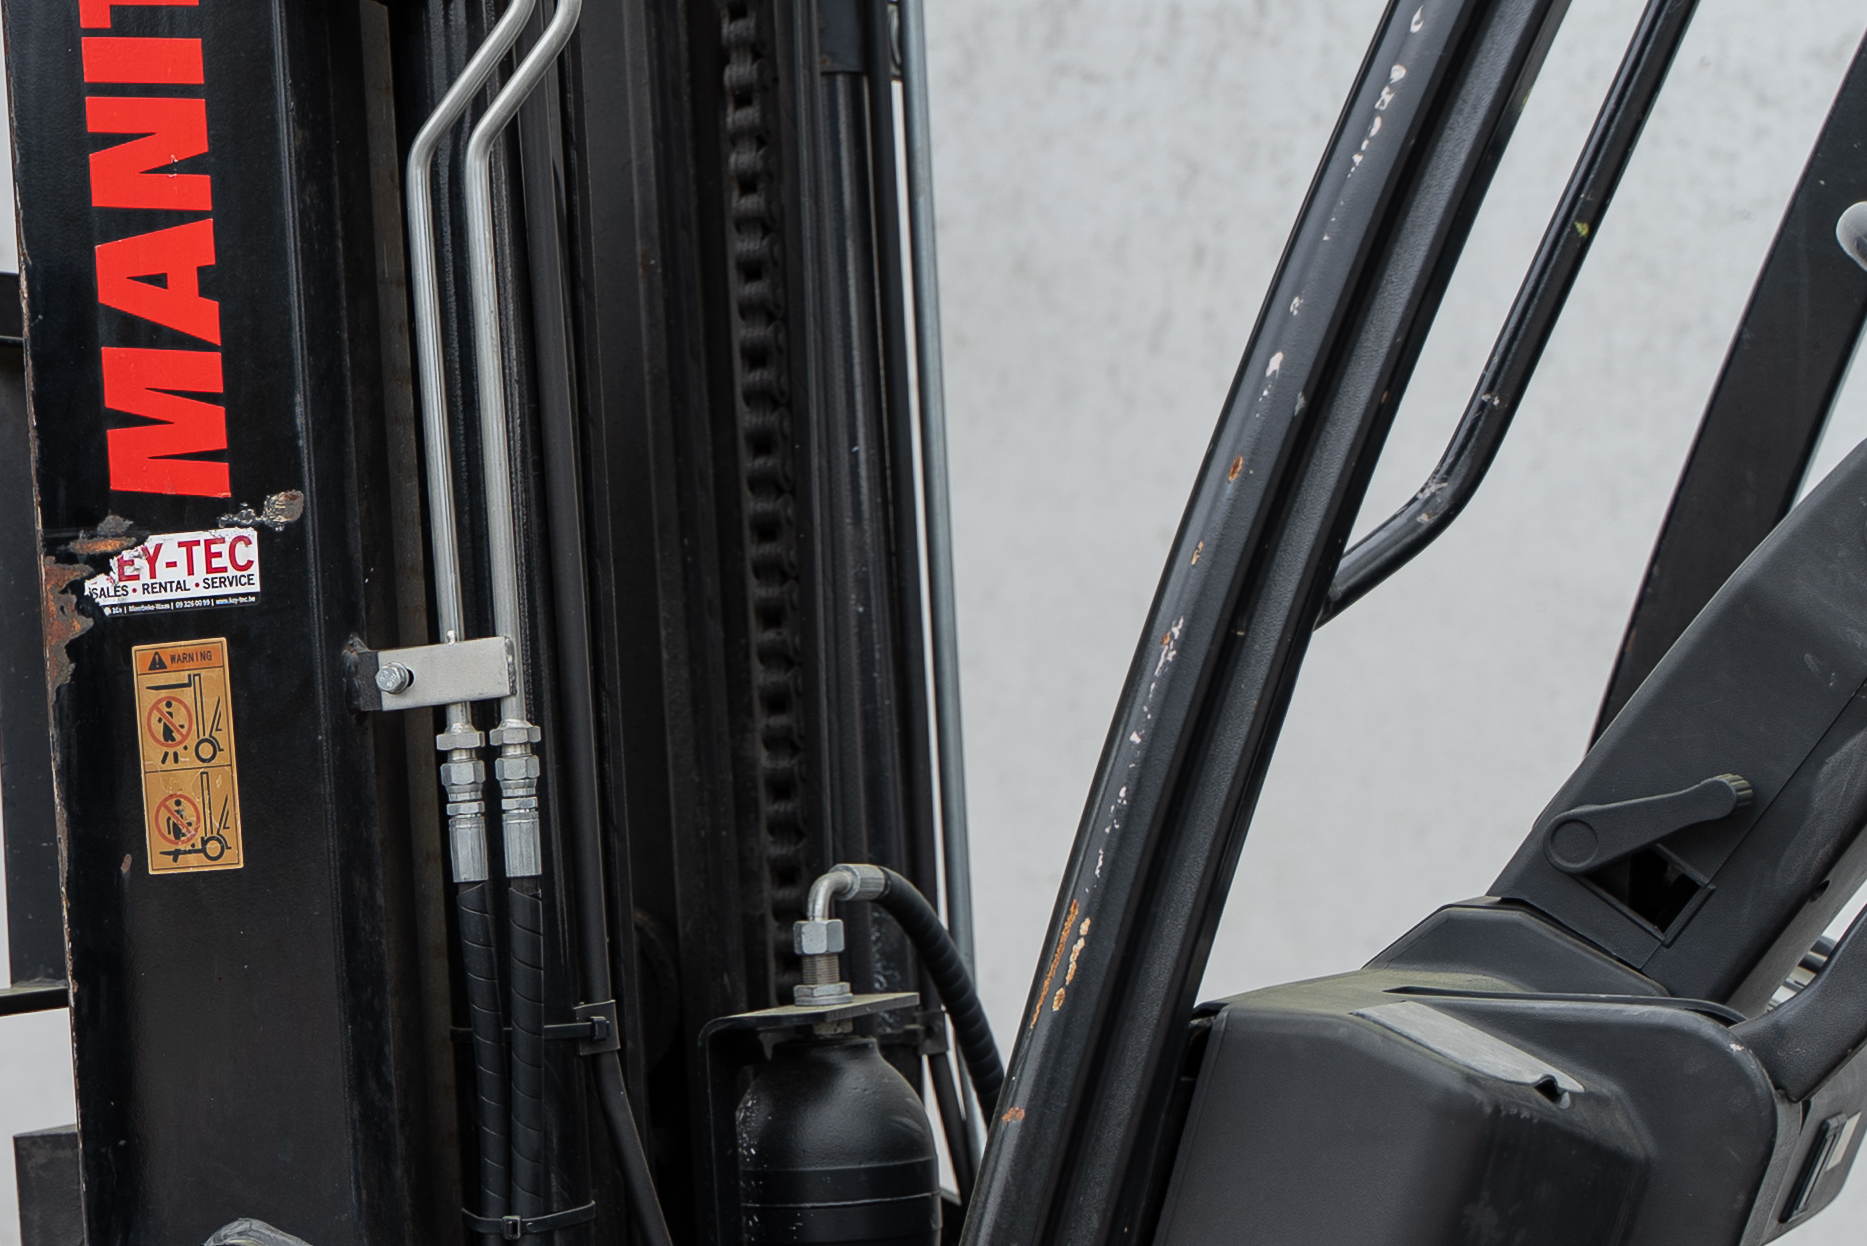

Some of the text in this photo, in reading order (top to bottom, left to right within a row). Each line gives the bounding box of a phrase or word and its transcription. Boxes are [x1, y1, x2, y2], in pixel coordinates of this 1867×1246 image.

[106, 535, 255, 582] EY-TEC
[91, 574, 255, 599] SALES RENTAL SERVICE
[169, 649, 213, 666] WARNING
